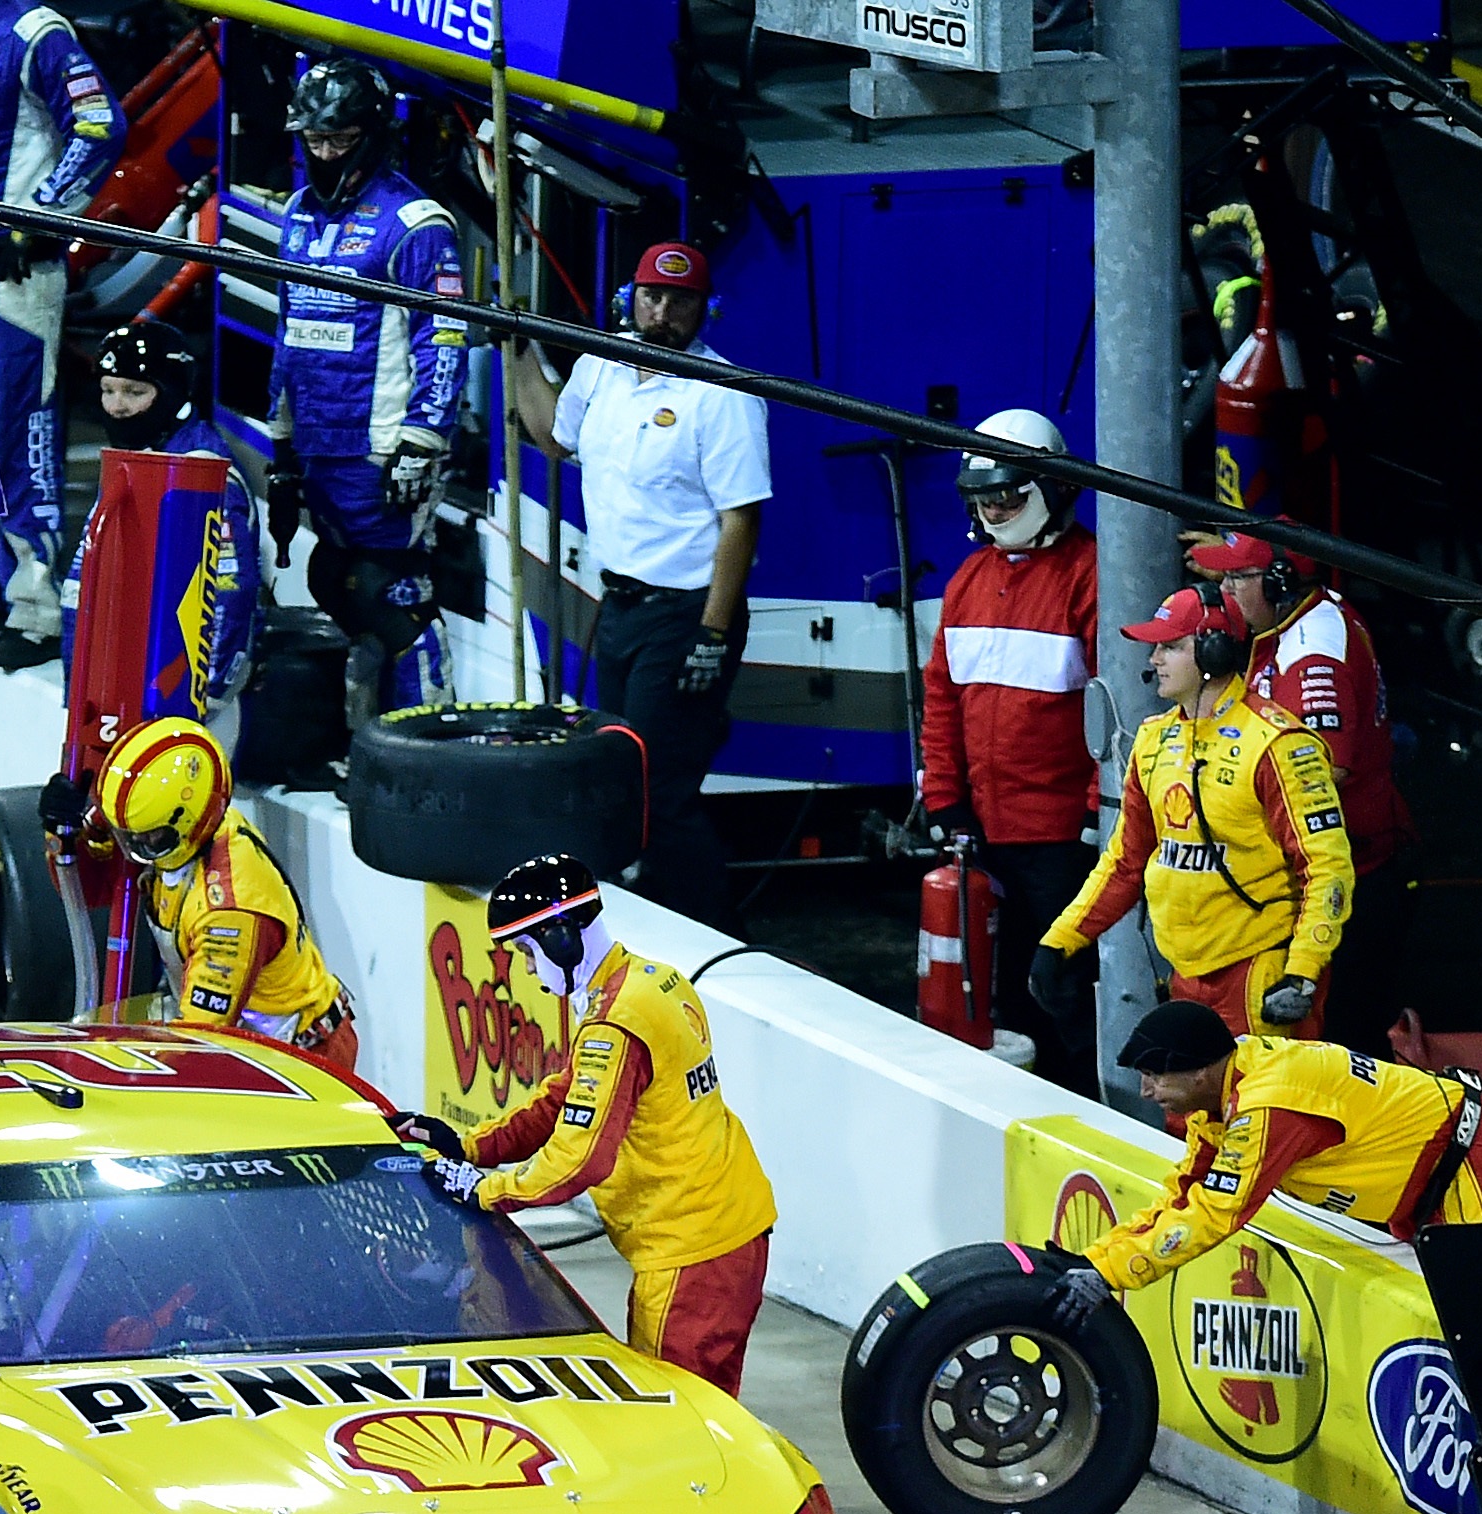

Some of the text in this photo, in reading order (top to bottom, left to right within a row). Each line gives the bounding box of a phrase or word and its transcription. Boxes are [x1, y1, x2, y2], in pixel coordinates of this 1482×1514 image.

[864, 5, 966, 48] MUSCO
[192, 990, 206, 1005] 22
[1192, 1301, 1306, 1377] PENNZOIL
[54, 1357, 672, 1434] PENNZOIL
